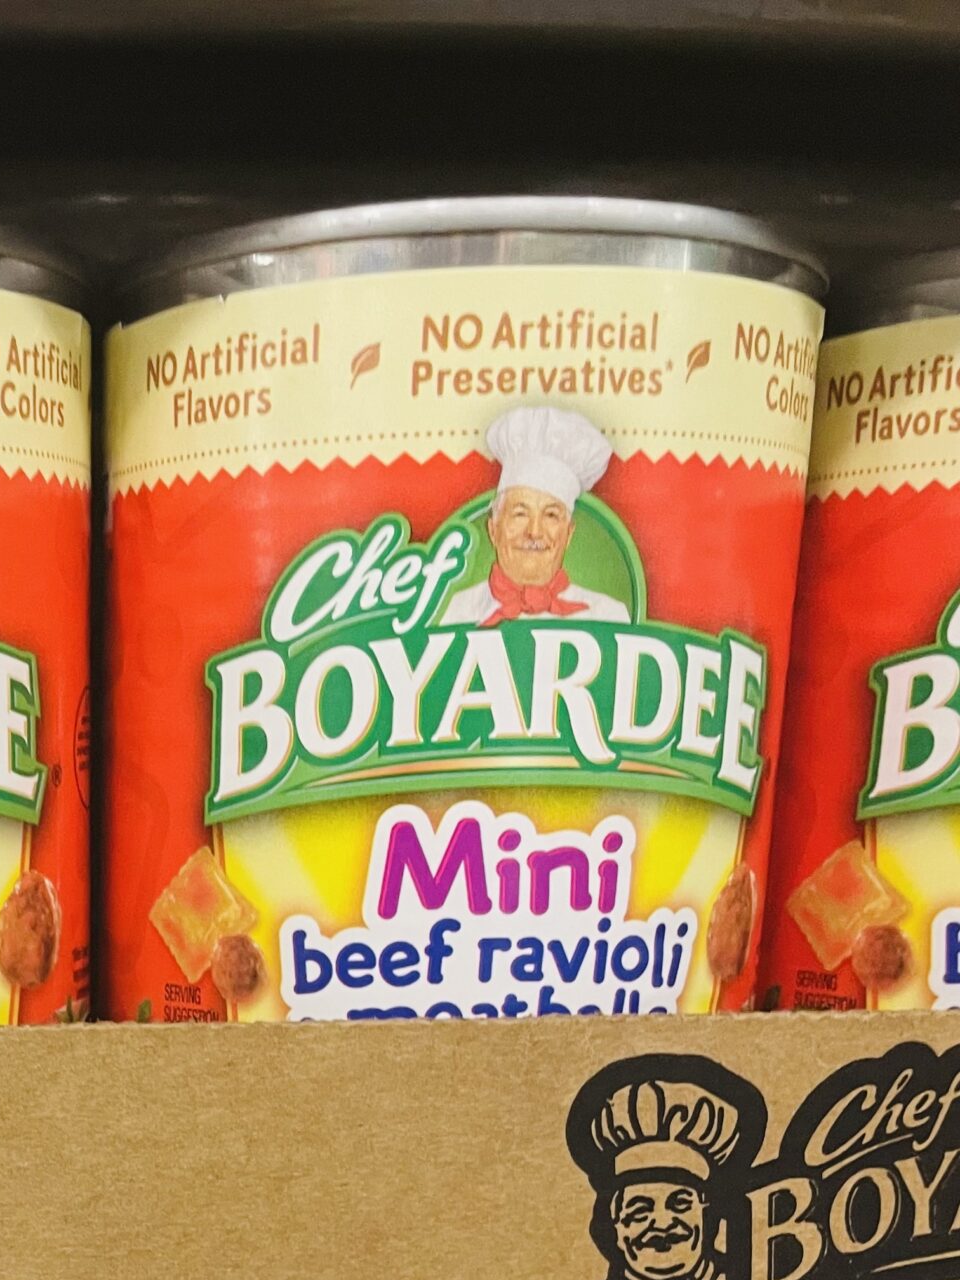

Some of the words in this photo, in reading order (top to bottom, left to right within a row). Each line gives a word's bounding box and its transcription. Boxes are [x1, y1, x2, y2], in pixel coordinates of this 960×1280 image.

[146, 352, 178, 393] NO
[182, 324, 320, 382] Artificial
[421, 312, 483, 352] NO
[491, 310, 659, 352] Artificial
[735, 322, 771, 363] NO
[6, 330, 83, 392] Artificial
[0, 381, 66, 428] Colors
[172, 382, 272, 429] Flavors
[766, 374, 809, 423] Colors
[827, 371, 863, 411] NO
[270, 528, 469, 643] Chef
[211, 628, 764, 803] BOYARDEE
[377, 815, 624, 920] Mini
[291, 918, 464, 994] beef
[476, 916, 691, 989] ravioli
[164, 983, 202, 1006] SERVING
[804, 1068, 960, 1167] Chef
